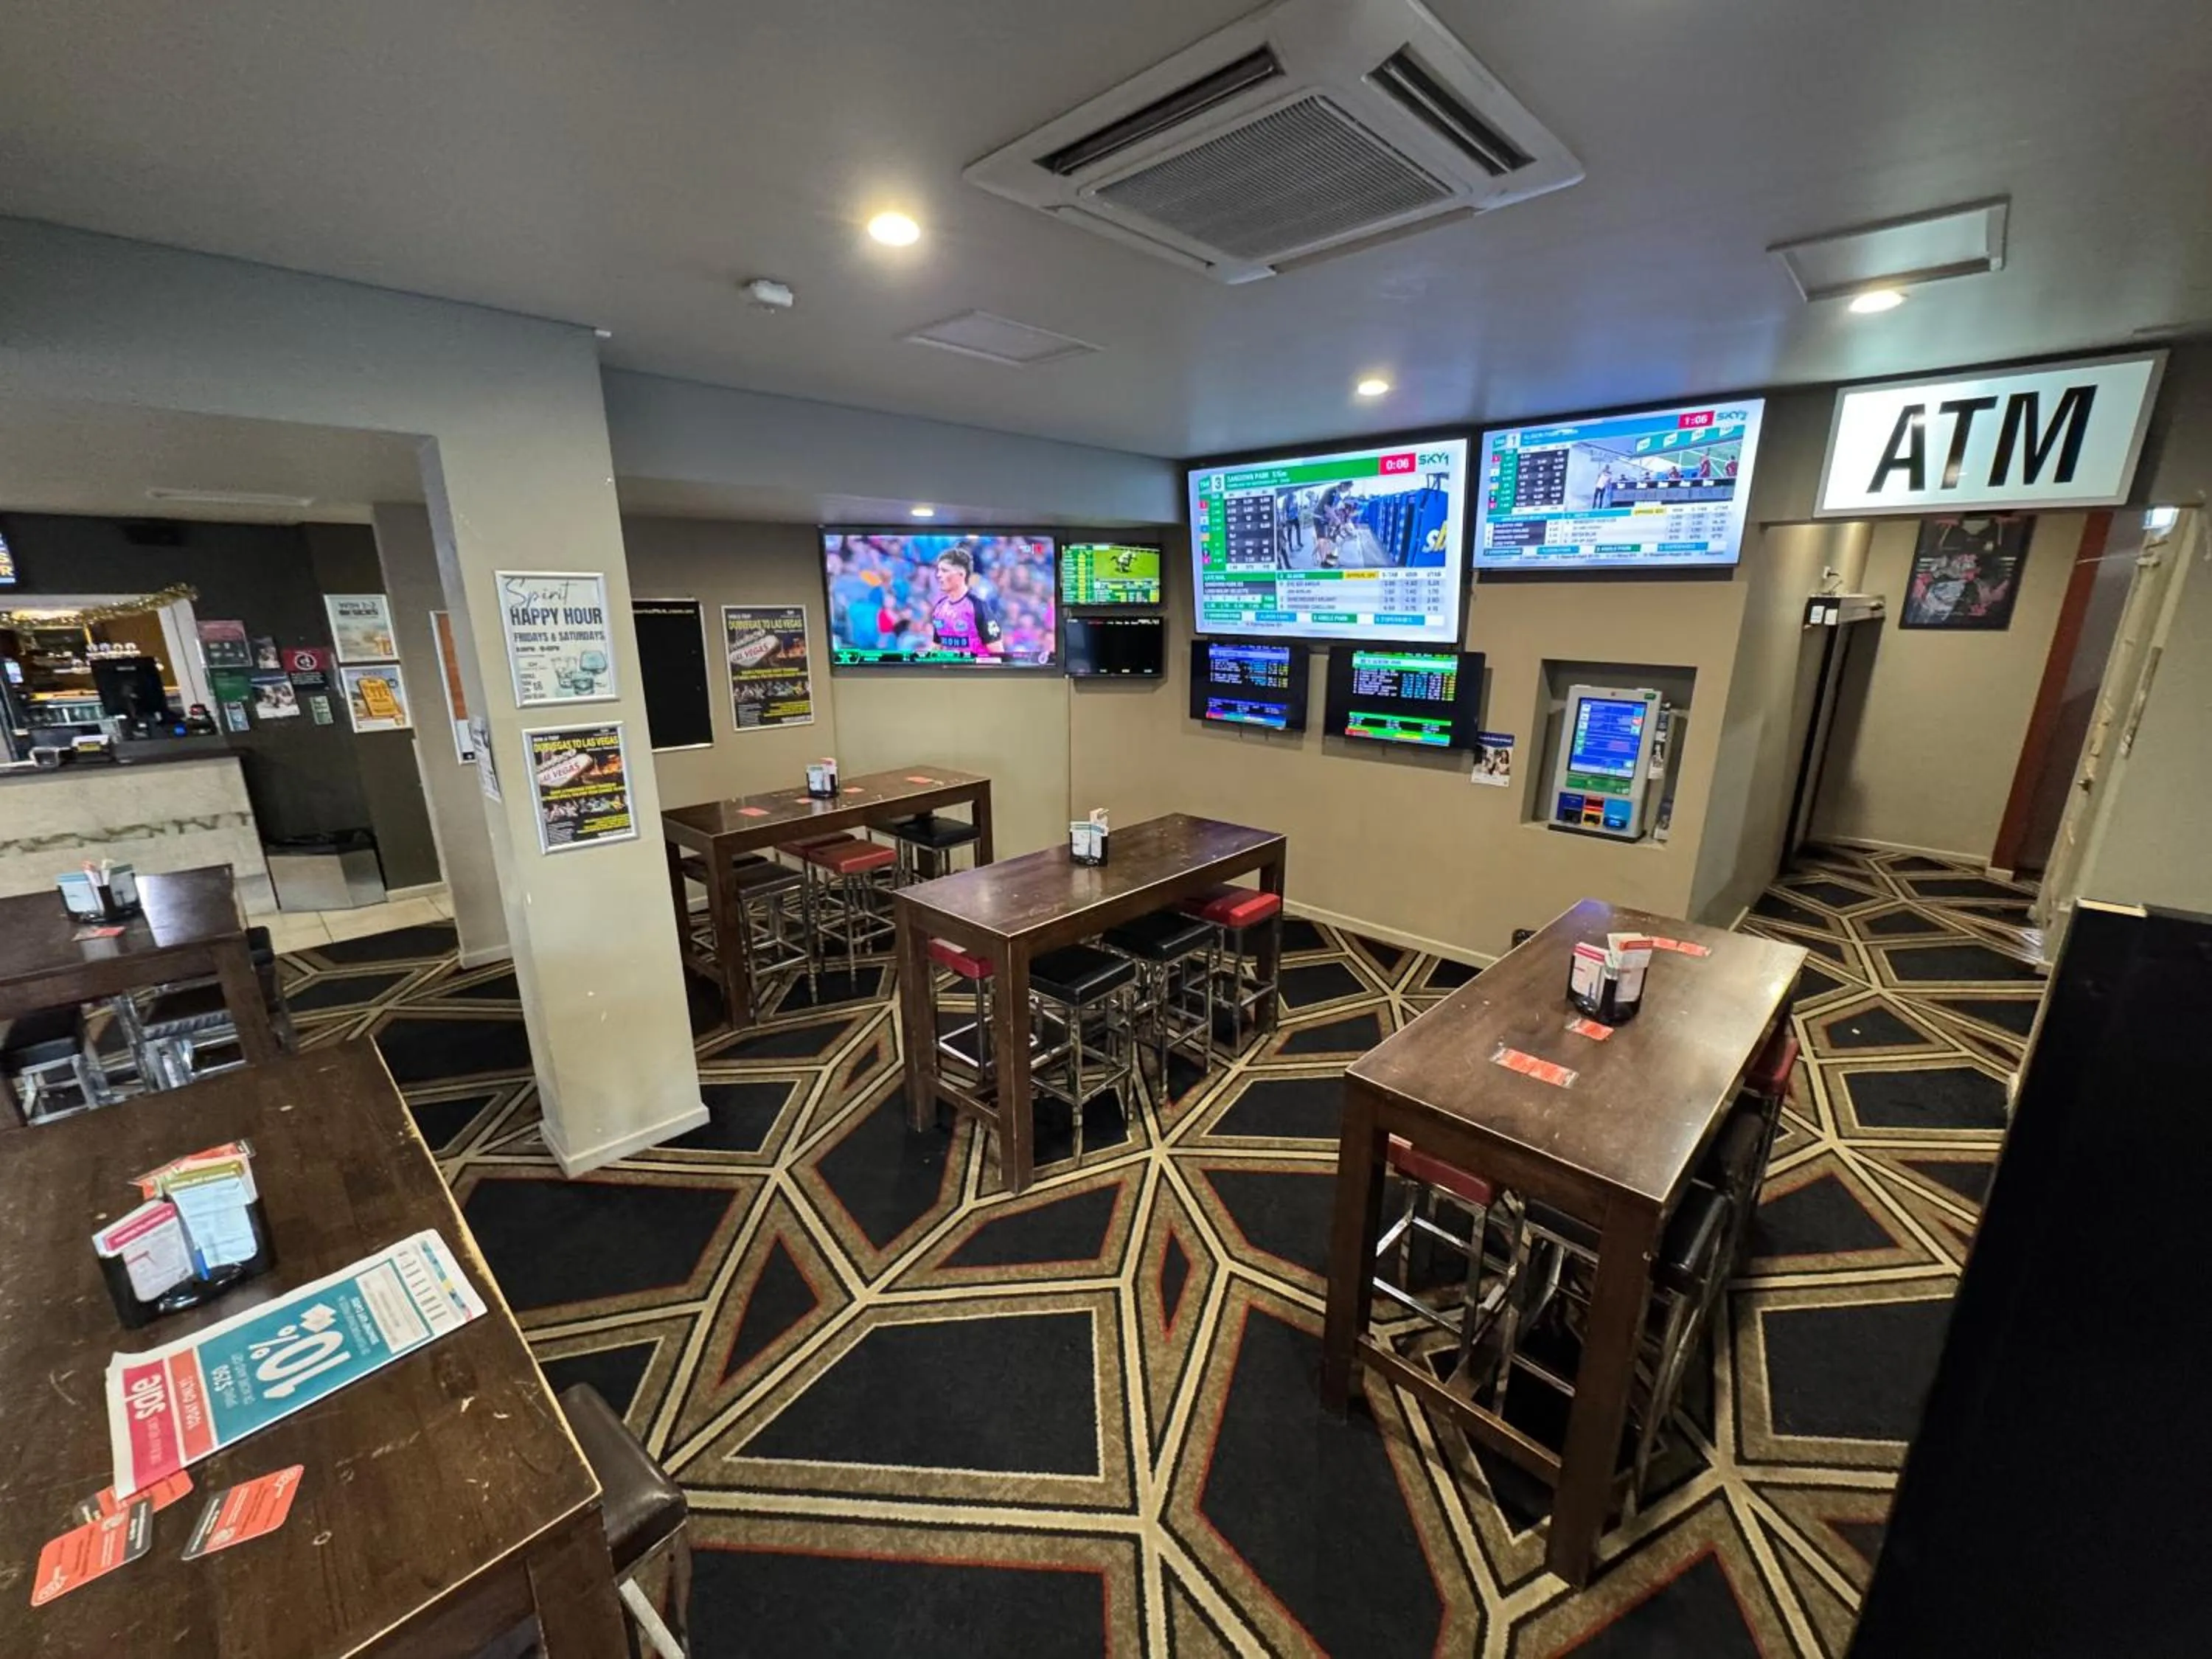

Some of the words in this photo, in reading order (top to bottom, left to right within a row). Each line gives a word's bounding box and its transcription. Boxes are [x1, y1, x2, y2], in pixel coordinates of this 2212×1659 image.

[1866, 385, 2098, 493] ATM
[1419, 452, 1449, 466] SKY1
[1214, 476, 1222, 490] 3
[506, 577, 578, 611] Spirit
[509, 607, 559, 626] HAPPY
[563, 607, 602, 625] HOUR
[514, 632, 549, 642] FRIDAYS
[551, 633, 557, 641] &
[559, 631, 605, 641] SATURDAYS
[582, 737, 596, 748] LAS
[597, 735, 619, 747] VEGAS
[247, 1325, 352, 1399] 10%
[124, 1373, 167, 1420] sale
